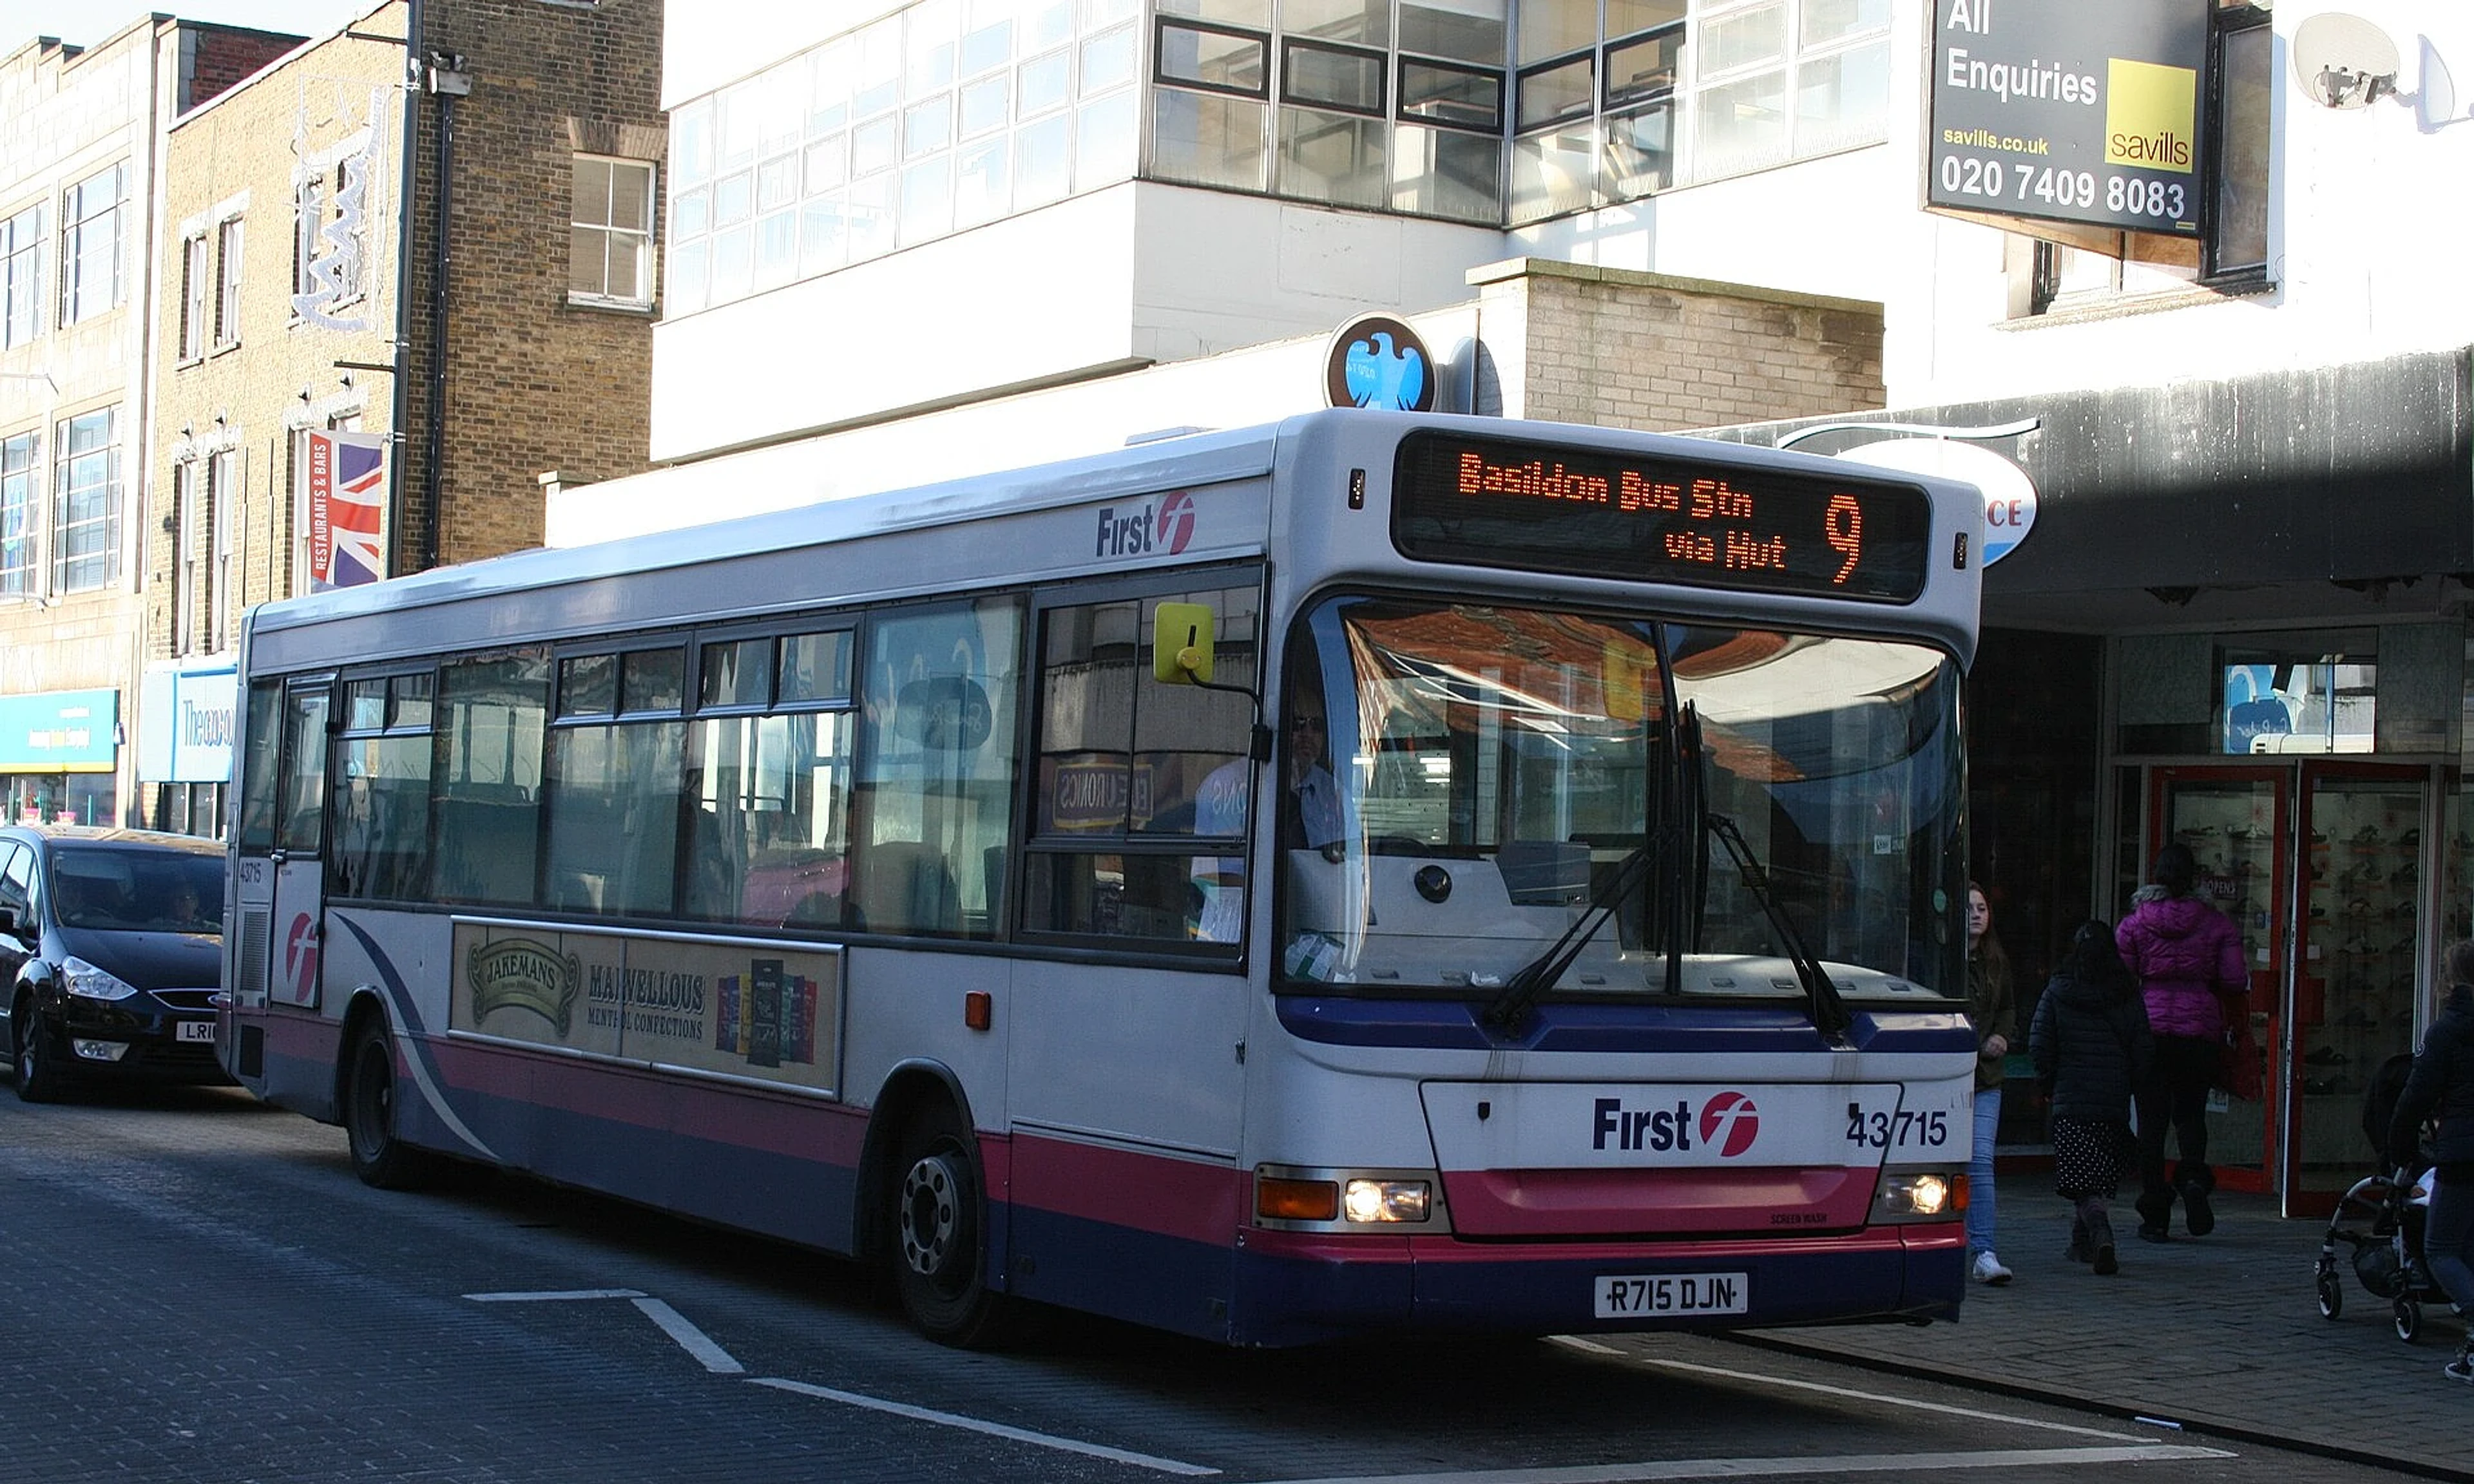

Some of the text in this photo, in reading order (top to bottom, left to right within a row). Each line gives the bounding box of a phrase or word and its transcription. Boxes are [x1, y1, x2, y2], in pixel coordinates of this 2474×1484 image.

[1947, 0, 1990, 34] All
[1947, 47, 2097, 105] Enquiries
[1943, 129, 2049, 156] savills.co.uk
[2111, 131, 2189, 166] savills
[1941, 155, 2185, 219] 020 7409 8083
[1459, 453, 1752, 518] Basildon Bus Stn
[313, 443, 327, 571] RESTAURANTS & BARS
[1096, 504, 1154, 558] First
[1665, 530, 1787, 569] via Hut
[1825, 494, 1862, 584] 9
[487, 953, 556, 991] JAKEMANS
[634, 1011, 703, 1041] CONFECTIONS
[1593, 1098, 1691, 1152] First
[1846, 1110, 1948, 1147] 43715
[1611, 1278, 1732, 1312] R715 DJN
